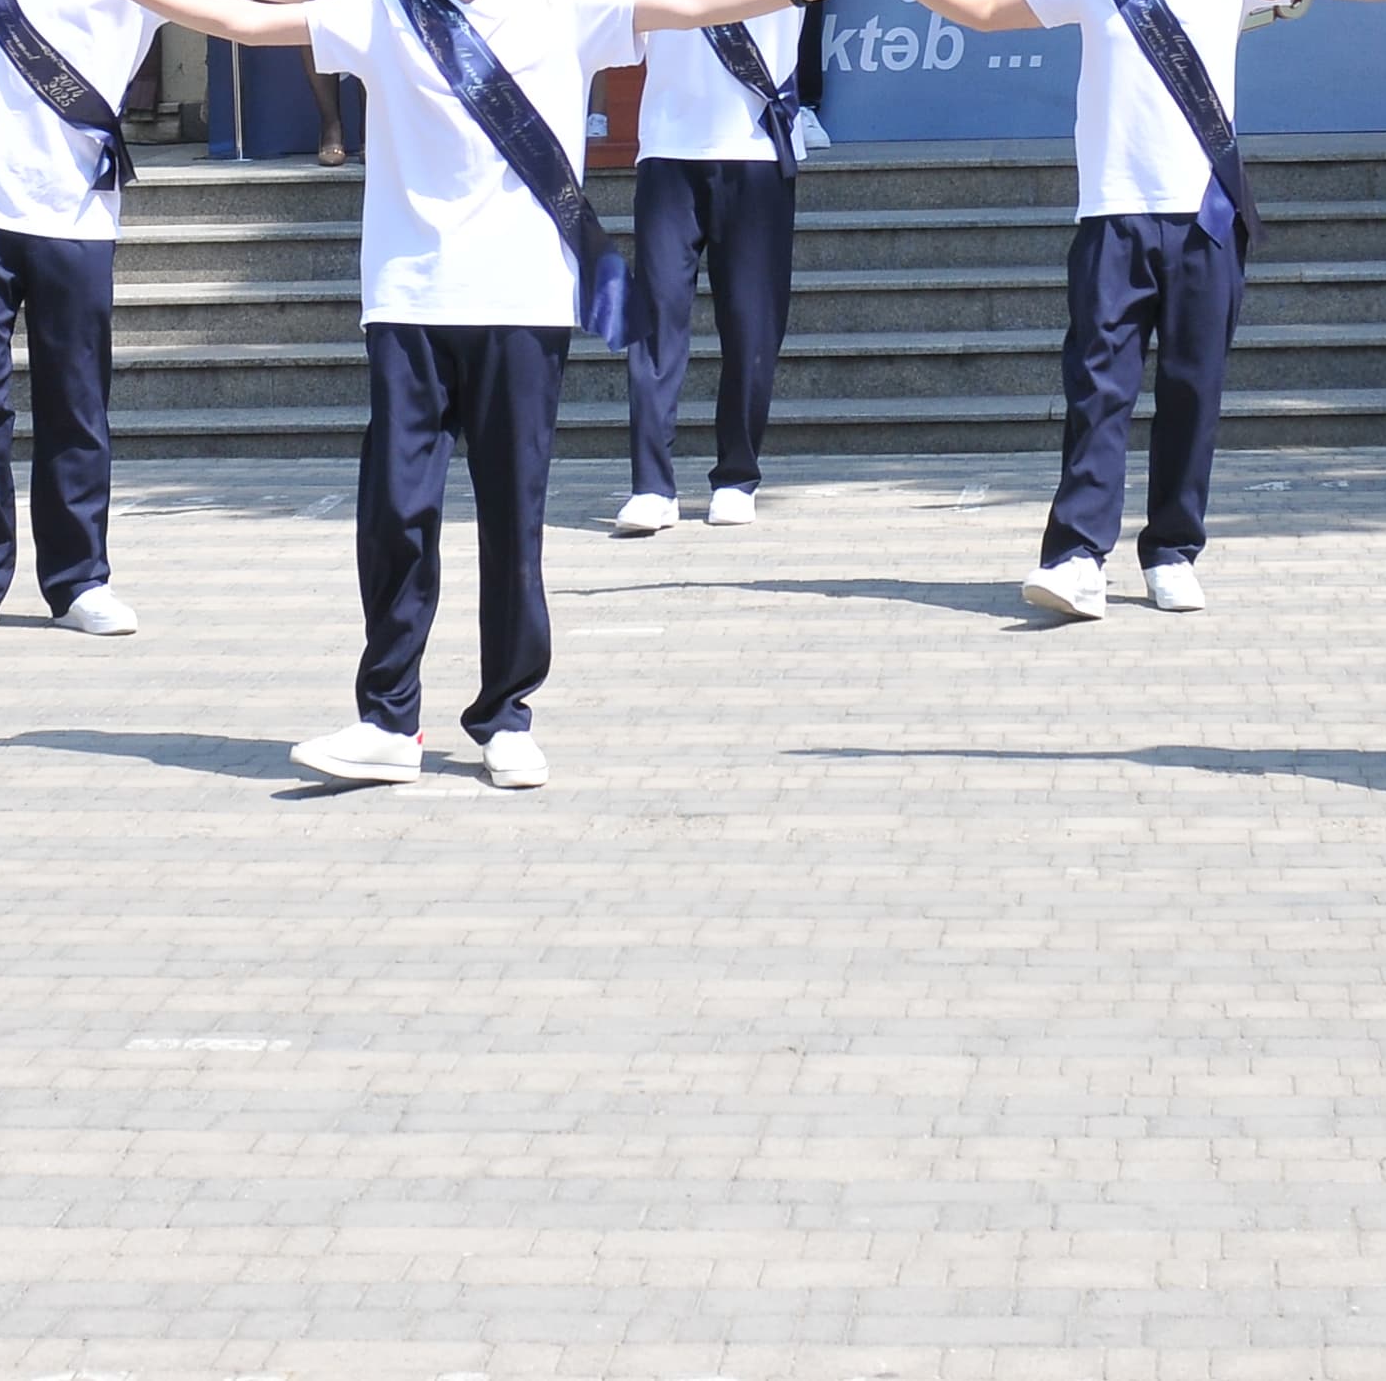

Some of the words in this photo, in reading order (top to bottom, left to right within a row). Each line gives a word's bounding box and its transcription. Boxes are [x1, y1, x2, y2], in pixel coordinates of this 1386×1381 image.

[822, 12, 965, 71] ktəb
[44, 77, 75, 108] 2025
[54, 72, 83, 101] 2014
